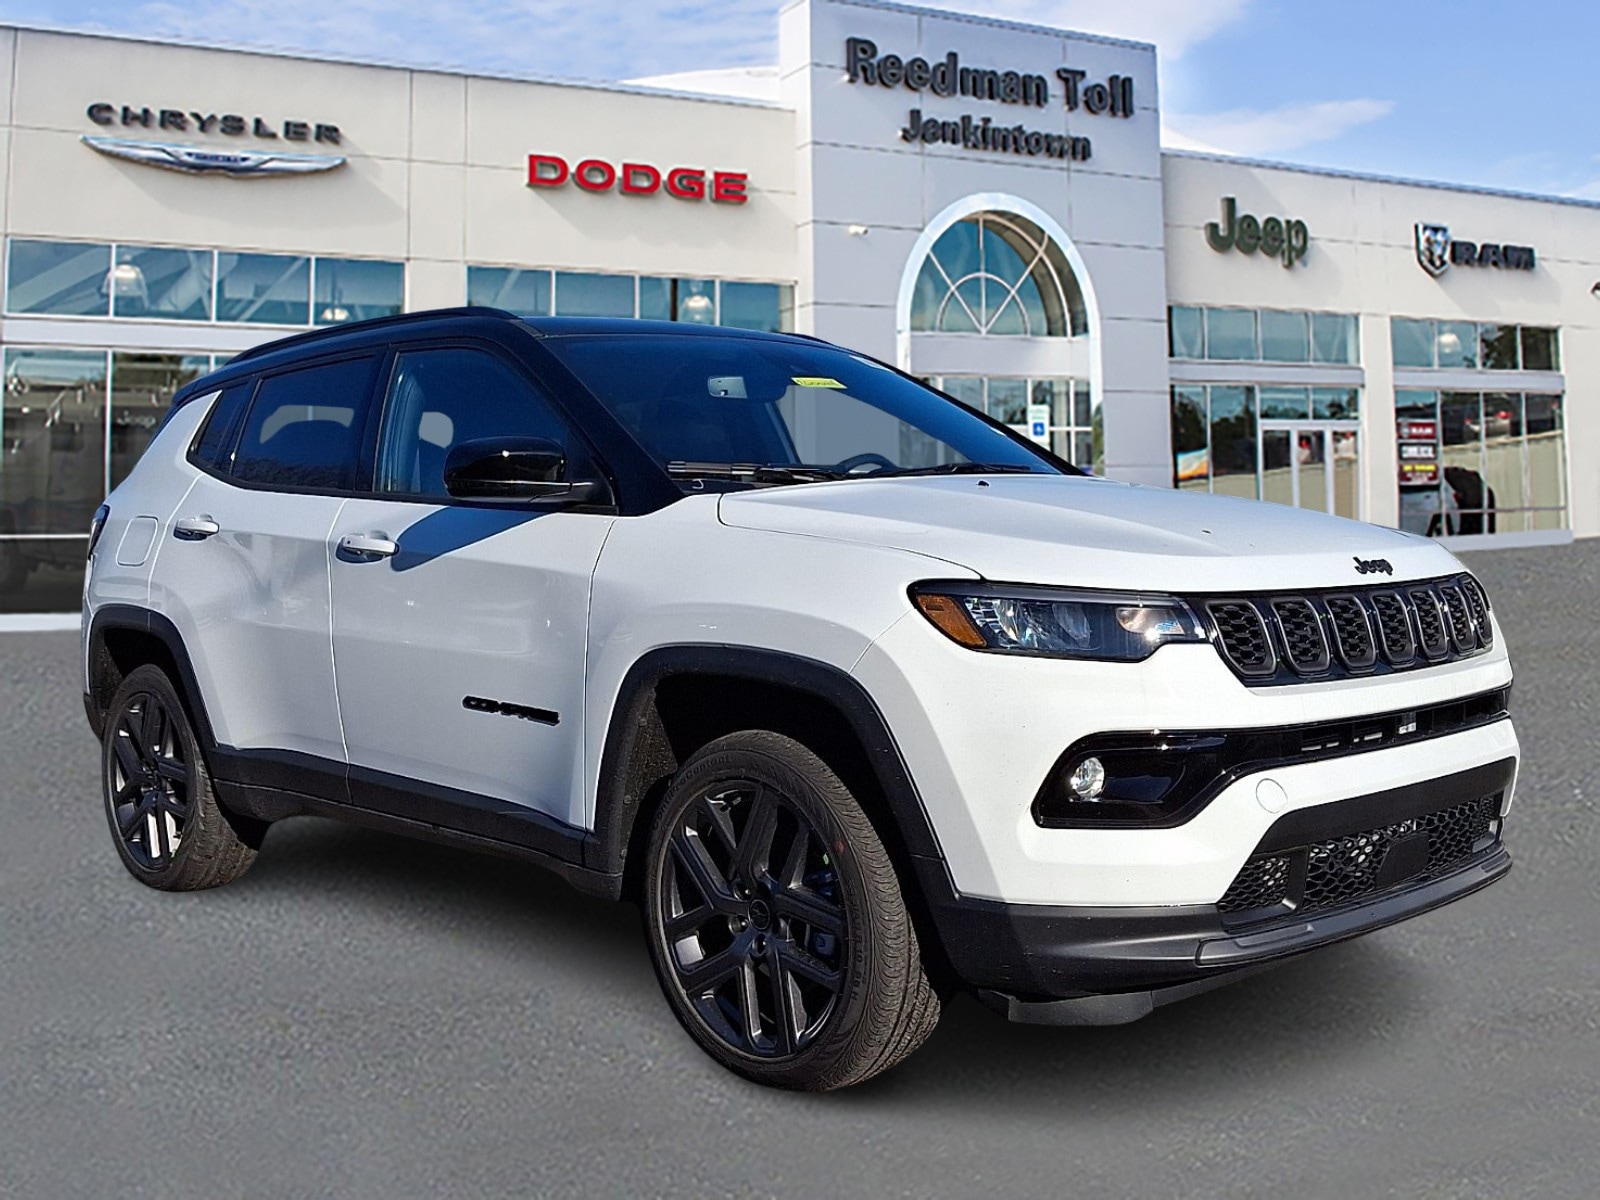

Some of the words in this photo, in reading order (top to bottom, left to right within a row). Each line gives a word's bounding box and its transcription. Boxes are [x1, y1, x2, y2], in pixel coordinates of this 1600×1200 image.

[846, 36, 1049, 107] Reedman
[1056, 66, 1134, 118] Toll
[86, 102, 341, 145] CHRYSLER
[902, 108, 1092, 161] Jenkintown
[526, 153, 749, 205] DODGE
[1204, 196, 1309, 270] Jeep
[1451, 240, 1536, 271] RAM
[1352, 556, 1394, 576] Jeep
